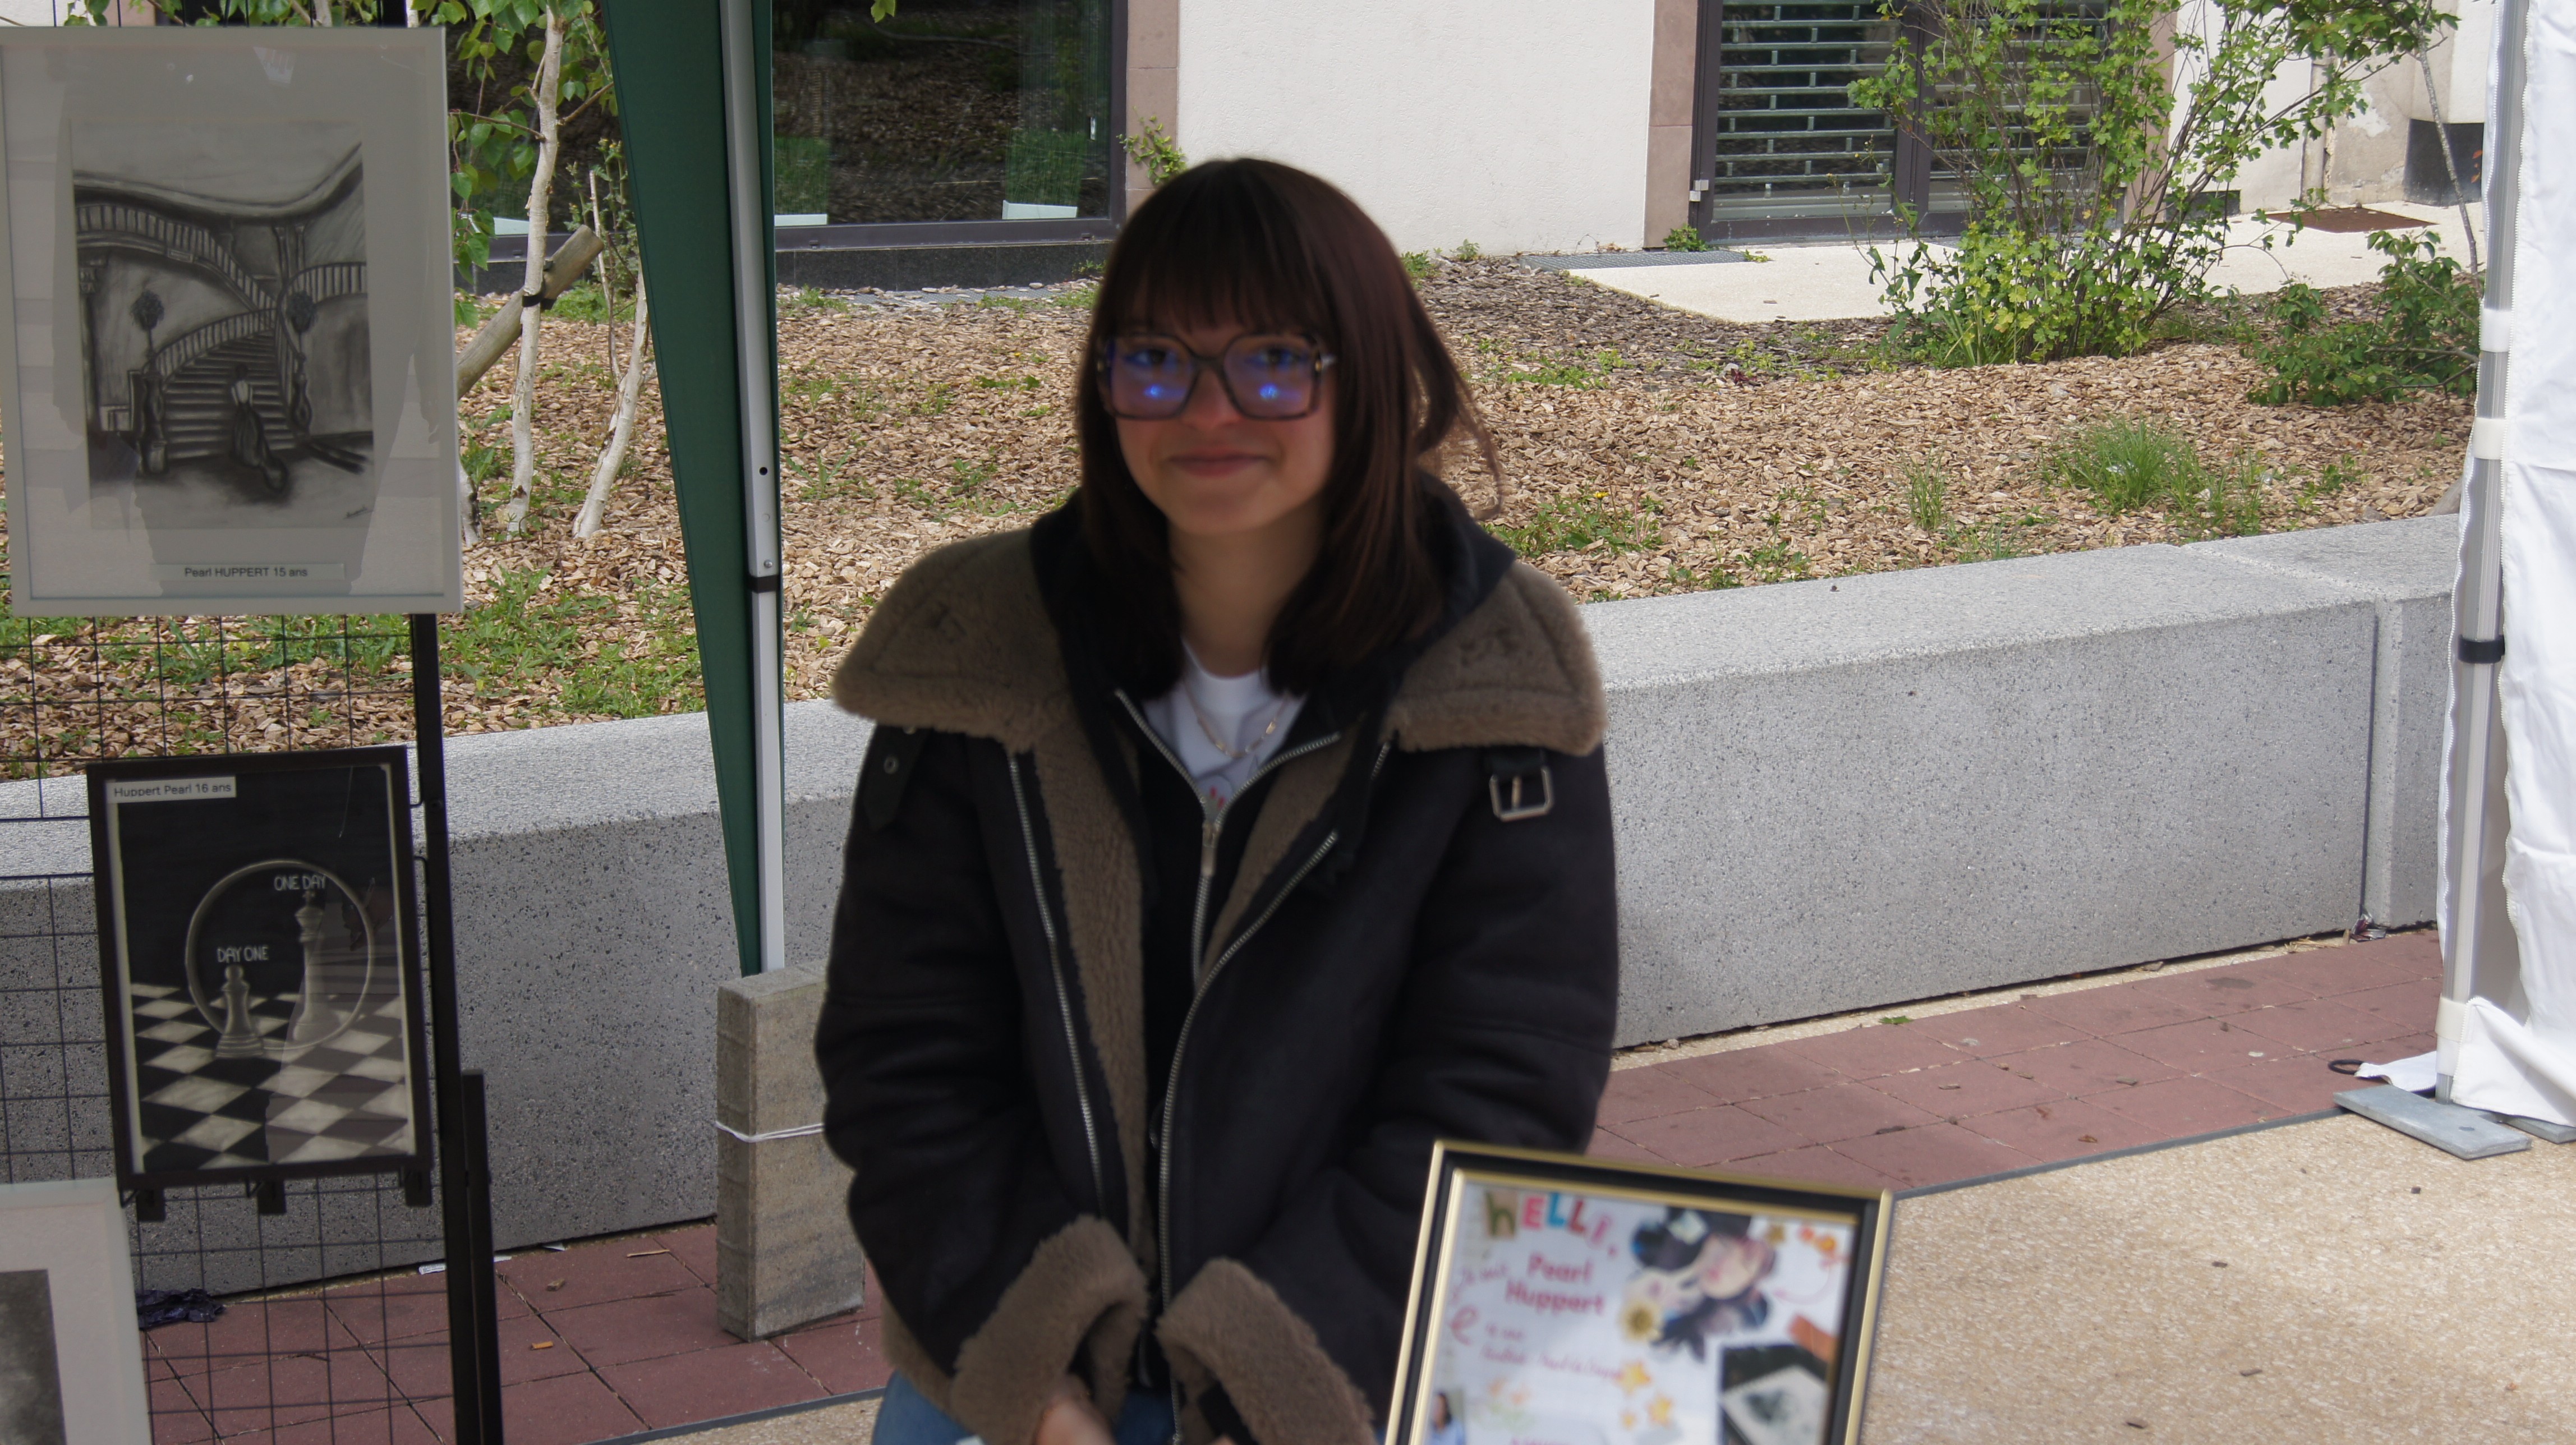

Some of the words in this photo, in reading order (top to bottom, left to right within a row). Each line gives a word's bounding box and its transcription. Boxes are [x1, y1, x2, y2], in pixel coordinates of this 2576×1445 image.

[184, 567, 211, 577] Pearl
[214, 567, 269, 577] HUPPERT
[273, 568, 286, 577] 15
[164, 785, 191, 795] Pearl
[195, 784, 209, 793] 16
[211, 784, 231, 793] ans
[274, 876, 300, 891] ONE
[302, 875, 326, 890] DAY
[217, 946, 242, 963] DAY
[243, 945, 269, 961] ONE
[1527, 1250, 1594, 1286] Pearl
[1505, 1279, 1606, 1317] Huppert
